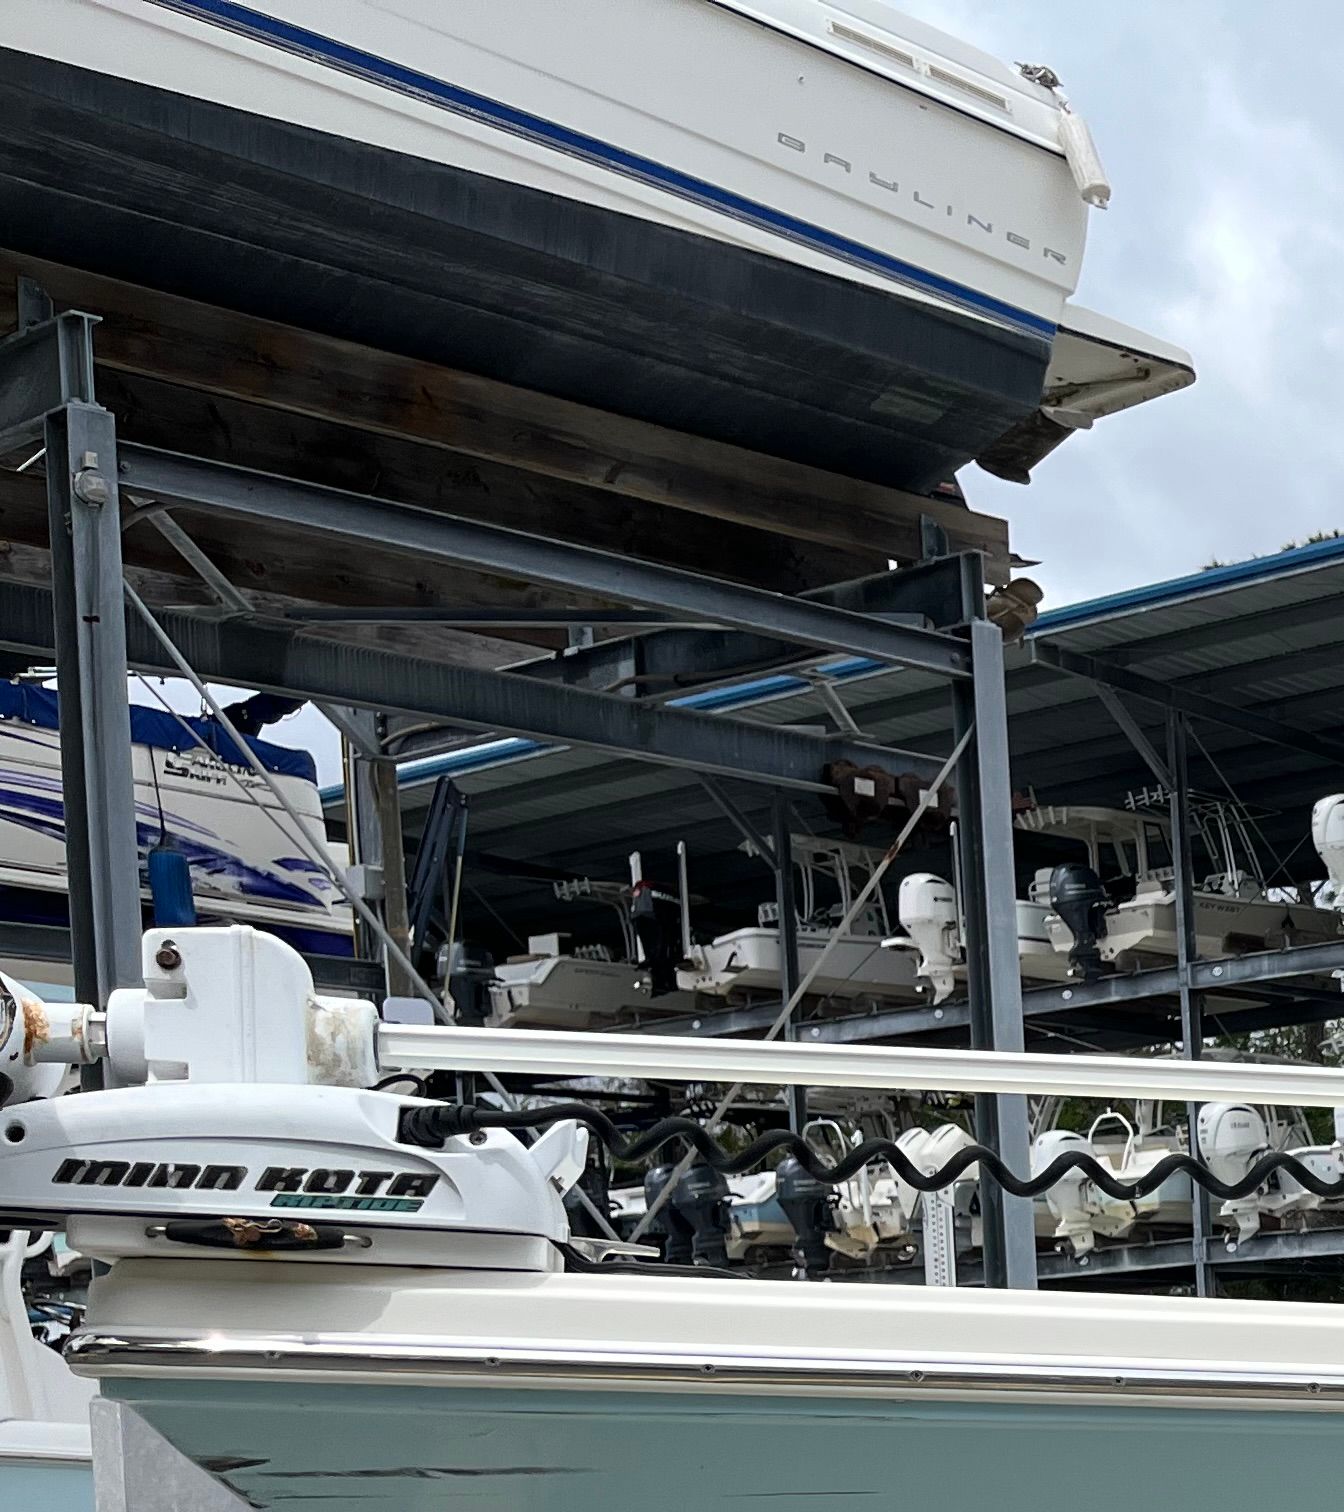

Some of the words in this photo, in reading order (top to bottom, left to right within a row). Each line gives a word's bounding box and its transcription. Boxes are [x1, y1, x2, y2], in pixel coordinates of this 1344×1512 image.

[778, 132, 1067, 266] BAYLINER
[51, 1158, 248, 1190] MINN
[254, 1167, 441, 1197] KOTA
[270, 1194, 425, 1213] RIPTIDE
